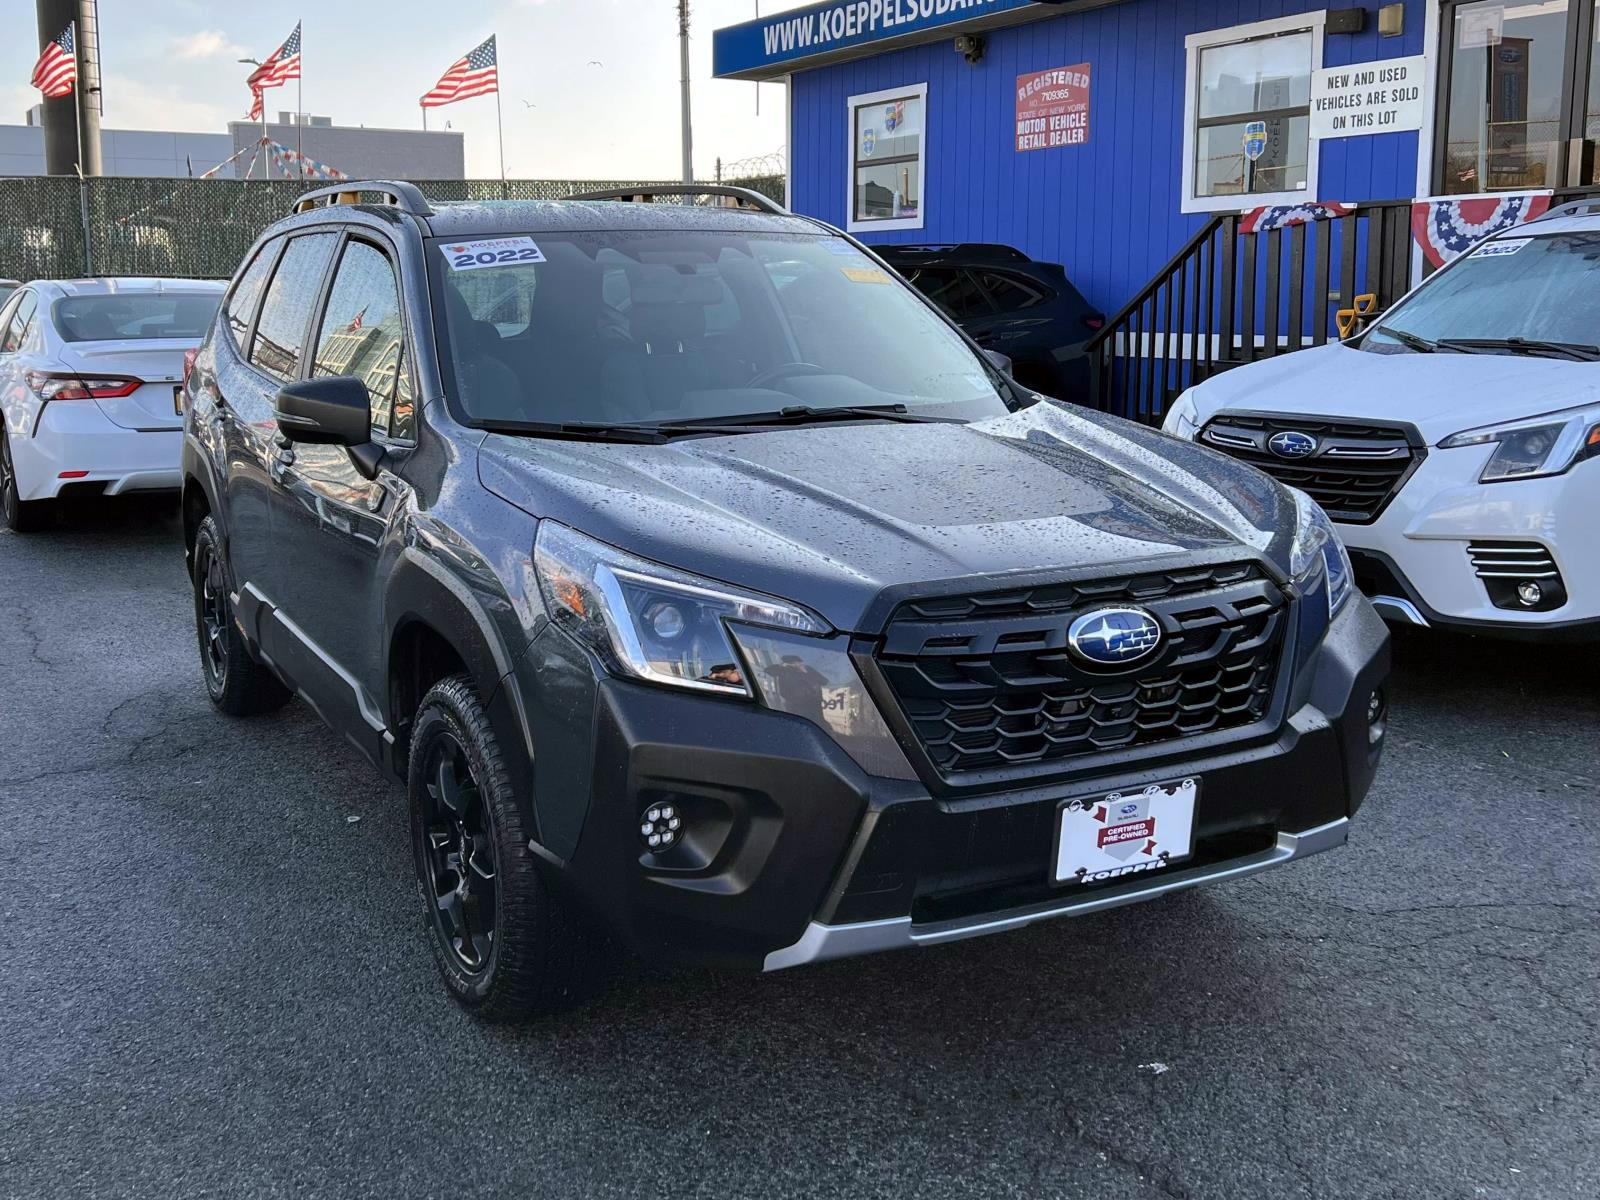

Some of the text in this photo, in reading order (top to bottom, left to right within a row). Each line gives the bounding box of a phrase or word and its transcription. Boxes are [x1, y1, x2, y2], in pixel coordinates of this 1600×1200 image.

[763, 0, 994, 55] WWW.KOEPPELSU
[1018, 71, 1089, 101] REGISTERED
[1327, 66, 1407, 90] NEW AND USED
[1049, 105, 1065, 115] NEW
[1067, 103, 1087, 113] YORK
[1316, 86, 1419, 111] VEHICLES ARE SOLD
[1017, 112, 1087, 135] MOTOR VEHICLE
[1332, 110, 1398, 129] ON THIS LOT
[1018, 128, 1084, 150] RETAIL DEALER
[454, 248, 540, 268] 2022
[1103, 828, 1149, 843] PRE-OWNED
[1107, 822, 1146, 836] CERTIFIED
[1080, 859, 1167, 883] KOEPPEL
